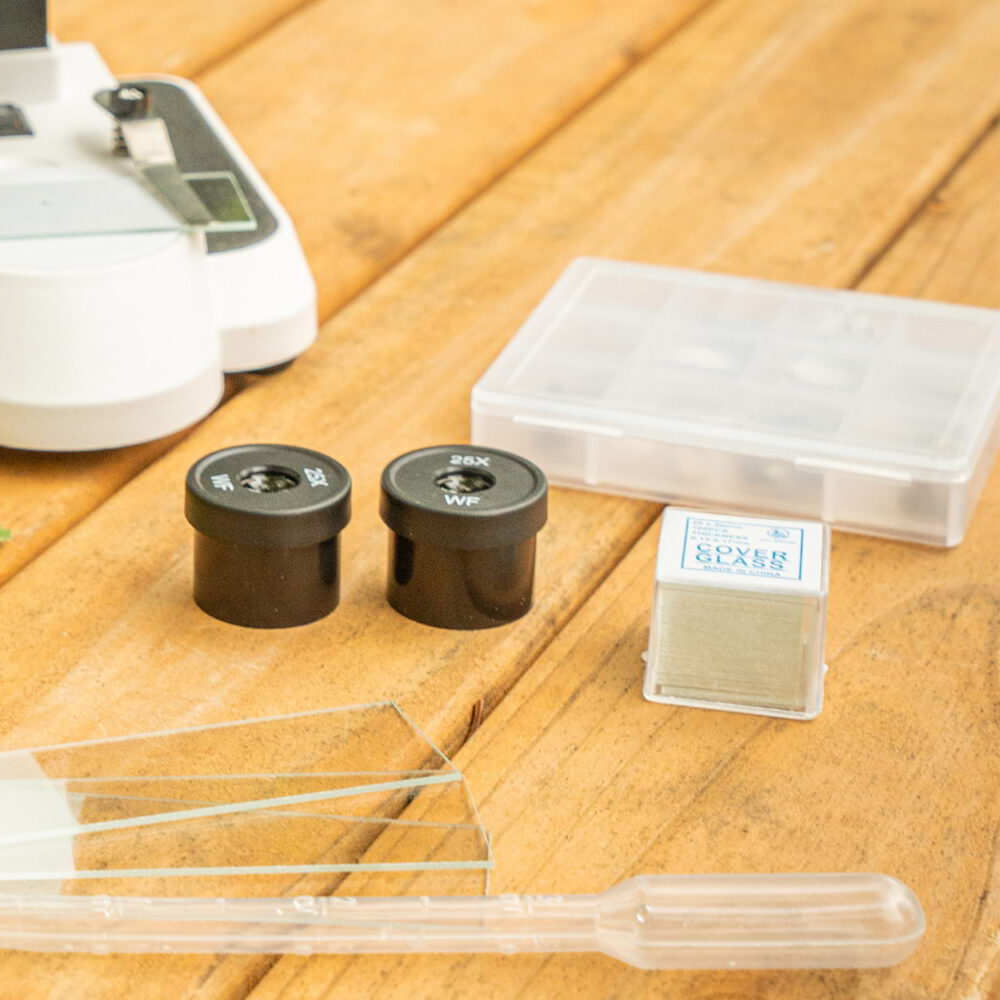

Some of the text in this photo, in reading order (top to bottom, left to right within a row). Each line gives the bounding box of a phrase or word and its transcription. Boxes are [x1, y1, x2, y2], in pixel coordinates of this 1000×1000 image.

[444, 494, 480, 507] WF
[695, 552, 785, 570] GLASS
[696, 543, 788, 562] COVER
